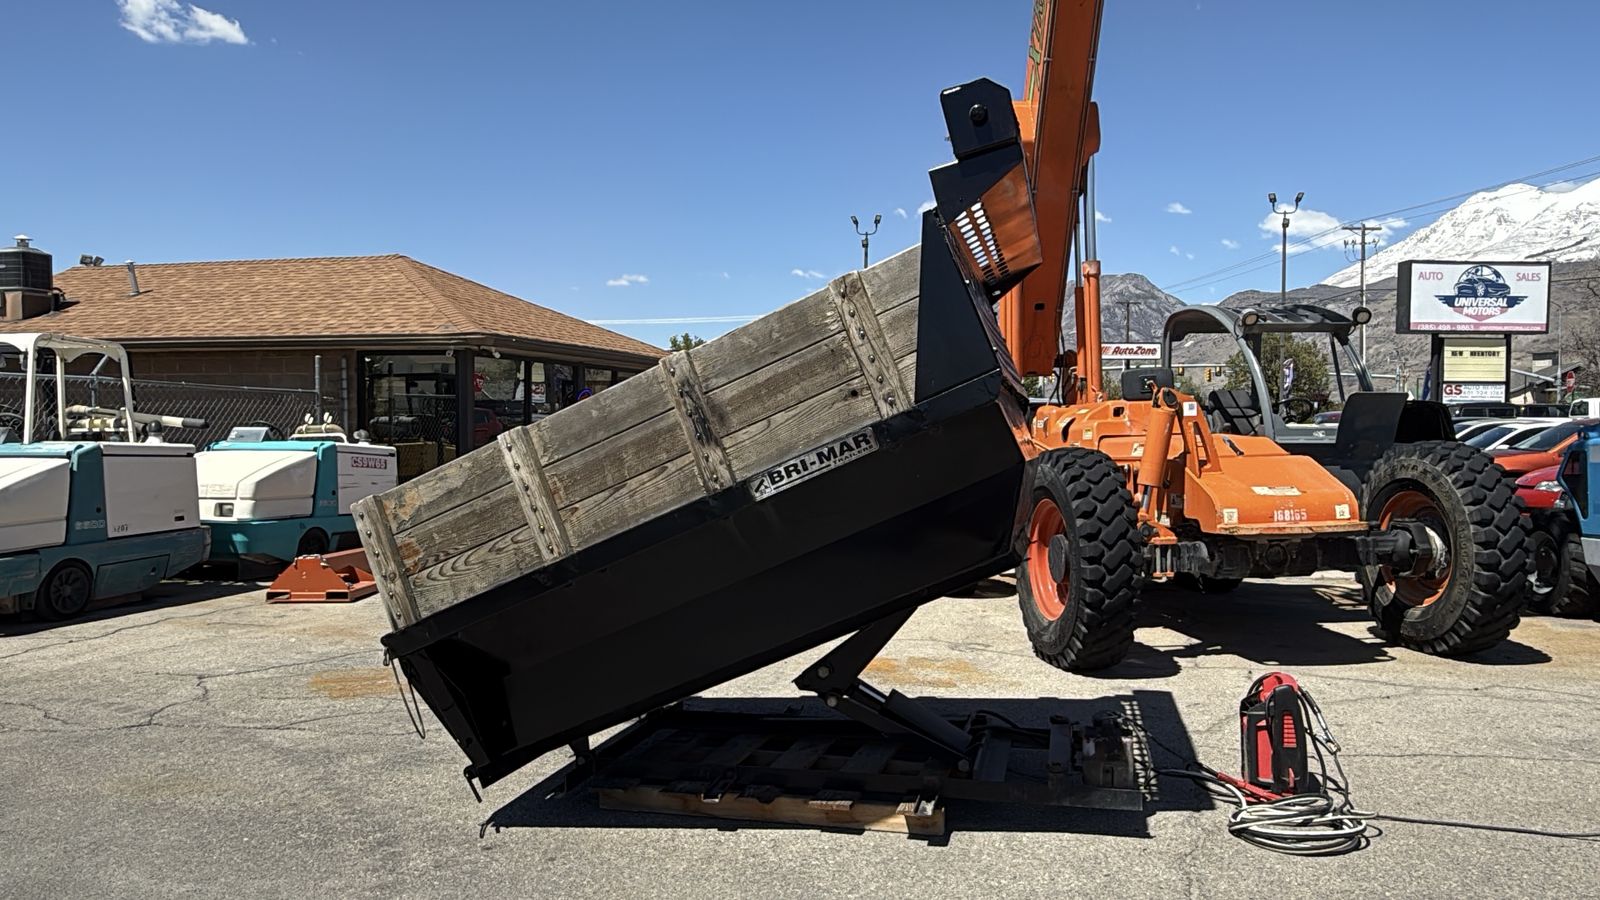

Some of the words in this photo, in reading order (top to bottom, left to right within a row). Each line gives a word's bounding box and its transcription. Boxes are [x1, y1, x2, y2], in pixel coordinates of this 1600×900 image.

[1418, 271, 1444, 281] AUTO
[1516, 272, 1541, 282] SALES
[1454, 297, 1508, 307] UNIVERSAL
[1462, 307, 1501, 316] MOTORS
[1112, 346, 1158, 356] AutoZone
[1443, 384, 1463, 396] GS
[352, 457, 386, 468] CS9W65
[767, 432, 872, 486] BRI-MAR
